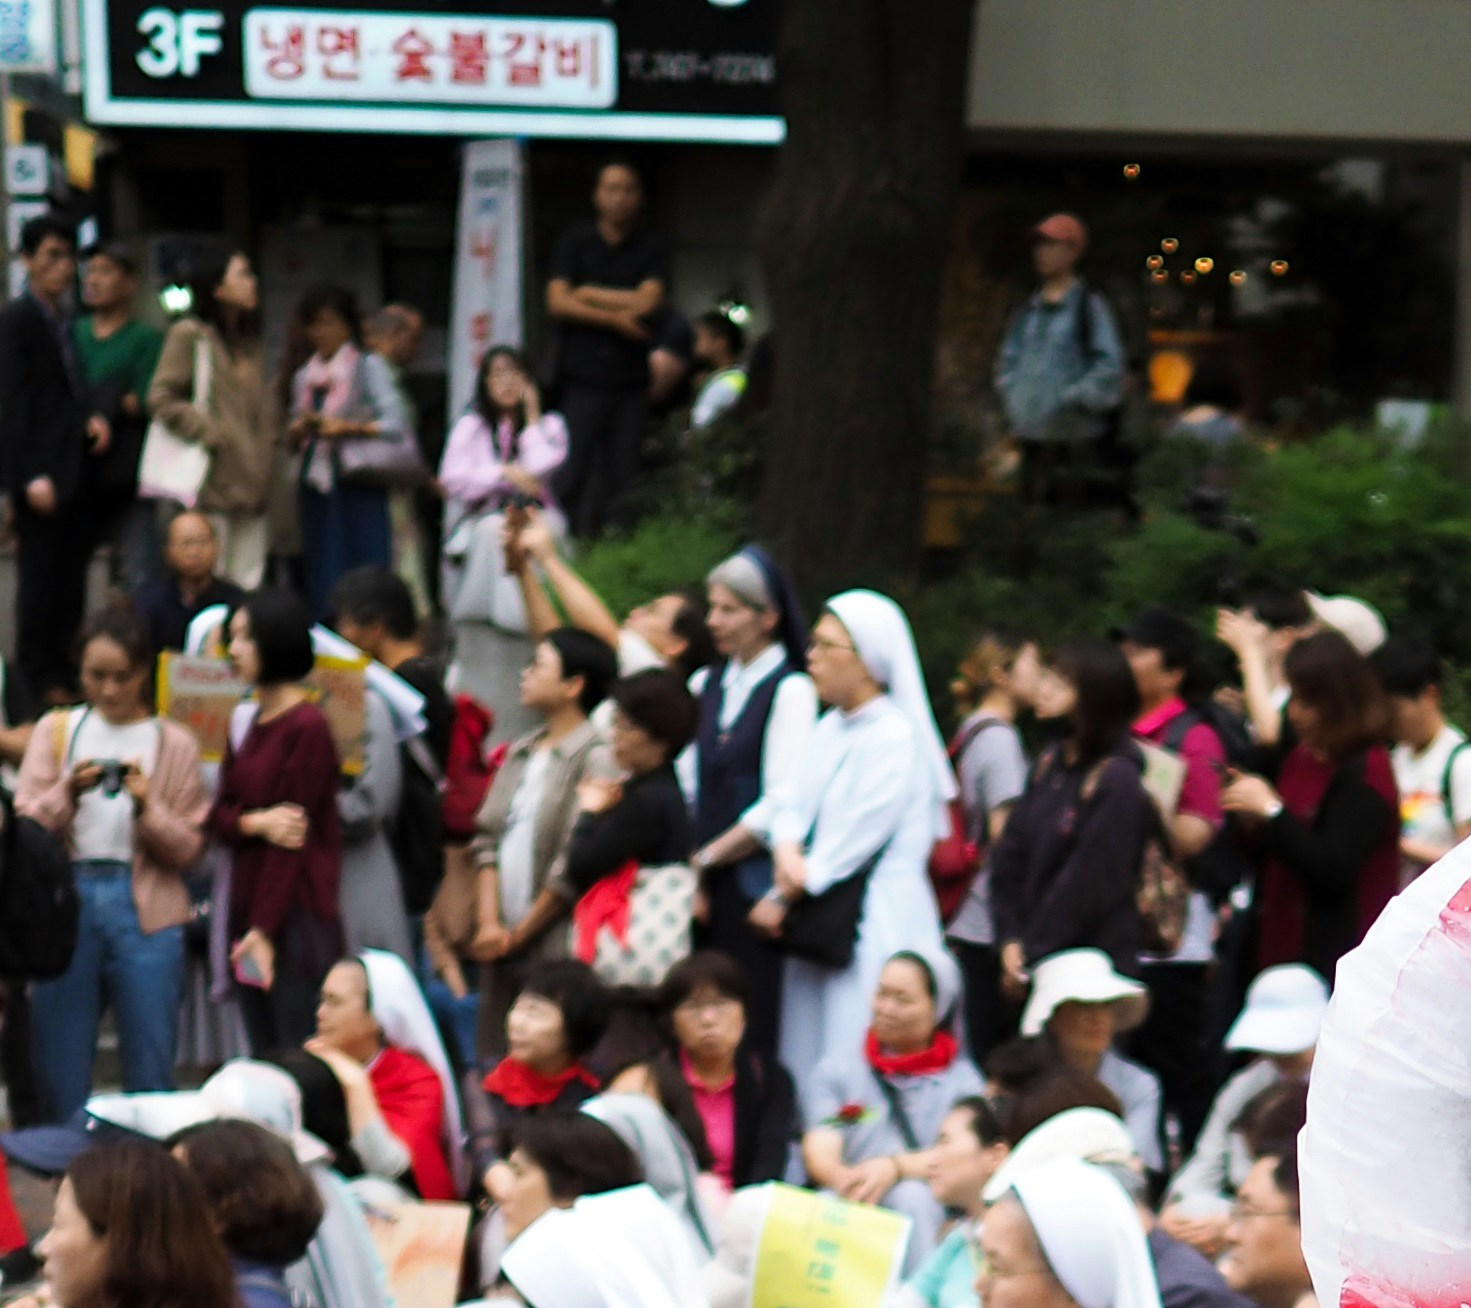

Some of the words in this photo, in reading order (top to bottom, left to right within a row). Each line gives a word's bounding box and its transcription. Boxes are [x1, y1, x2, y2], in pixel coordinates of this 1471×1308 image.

[136, 10, 223, 77] 3F
[260, 24, 360, 81] 냉면
[390, 27, 599, 89] 숯불갈비
